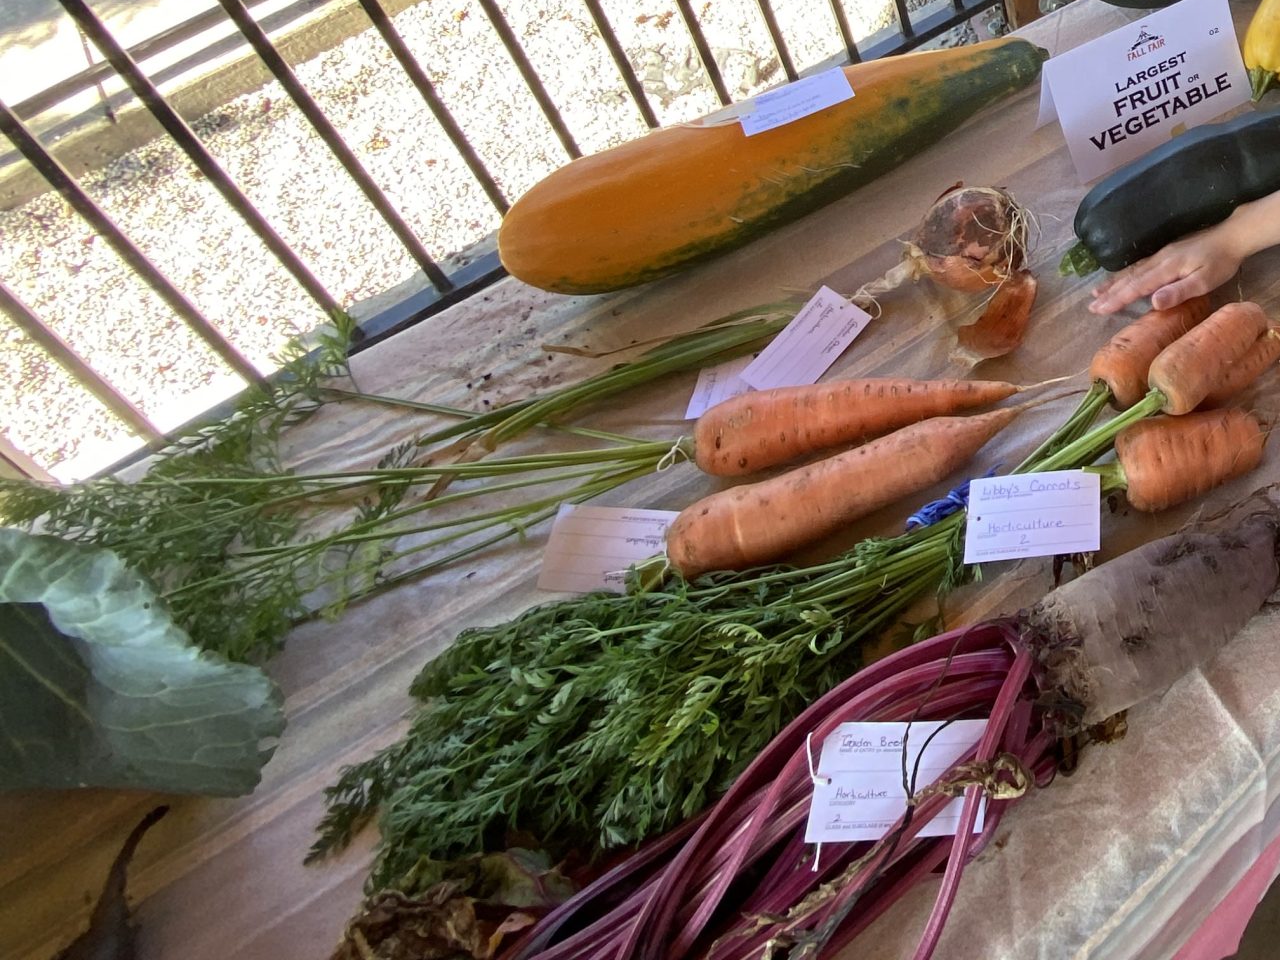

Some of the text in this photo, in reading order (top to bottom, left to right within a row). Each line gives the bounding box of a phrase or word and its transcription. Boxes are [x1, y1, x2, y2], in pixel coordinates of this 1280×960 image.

[1209, 27, 1220, 36] 02
[1127, 48, 1146, 61] FALL
[1148, 38, 1165, 52] FAIR
[1115, 51, 1187, 93] LARGEST
[1113, 71, 1200, 118] FRUIT OR
[1089, 72, 1232, 151] VEGETABLE
[982, 482, 1020, 500] Libby's
[1029, 478, 1081, 492] Carrots
[988, 518, 1065, 534] Horticulture
[1020, 533, 1030, 545] 2
[834, 785, 889, 800] Horticulture
[831, 813, 842, 824] 2
